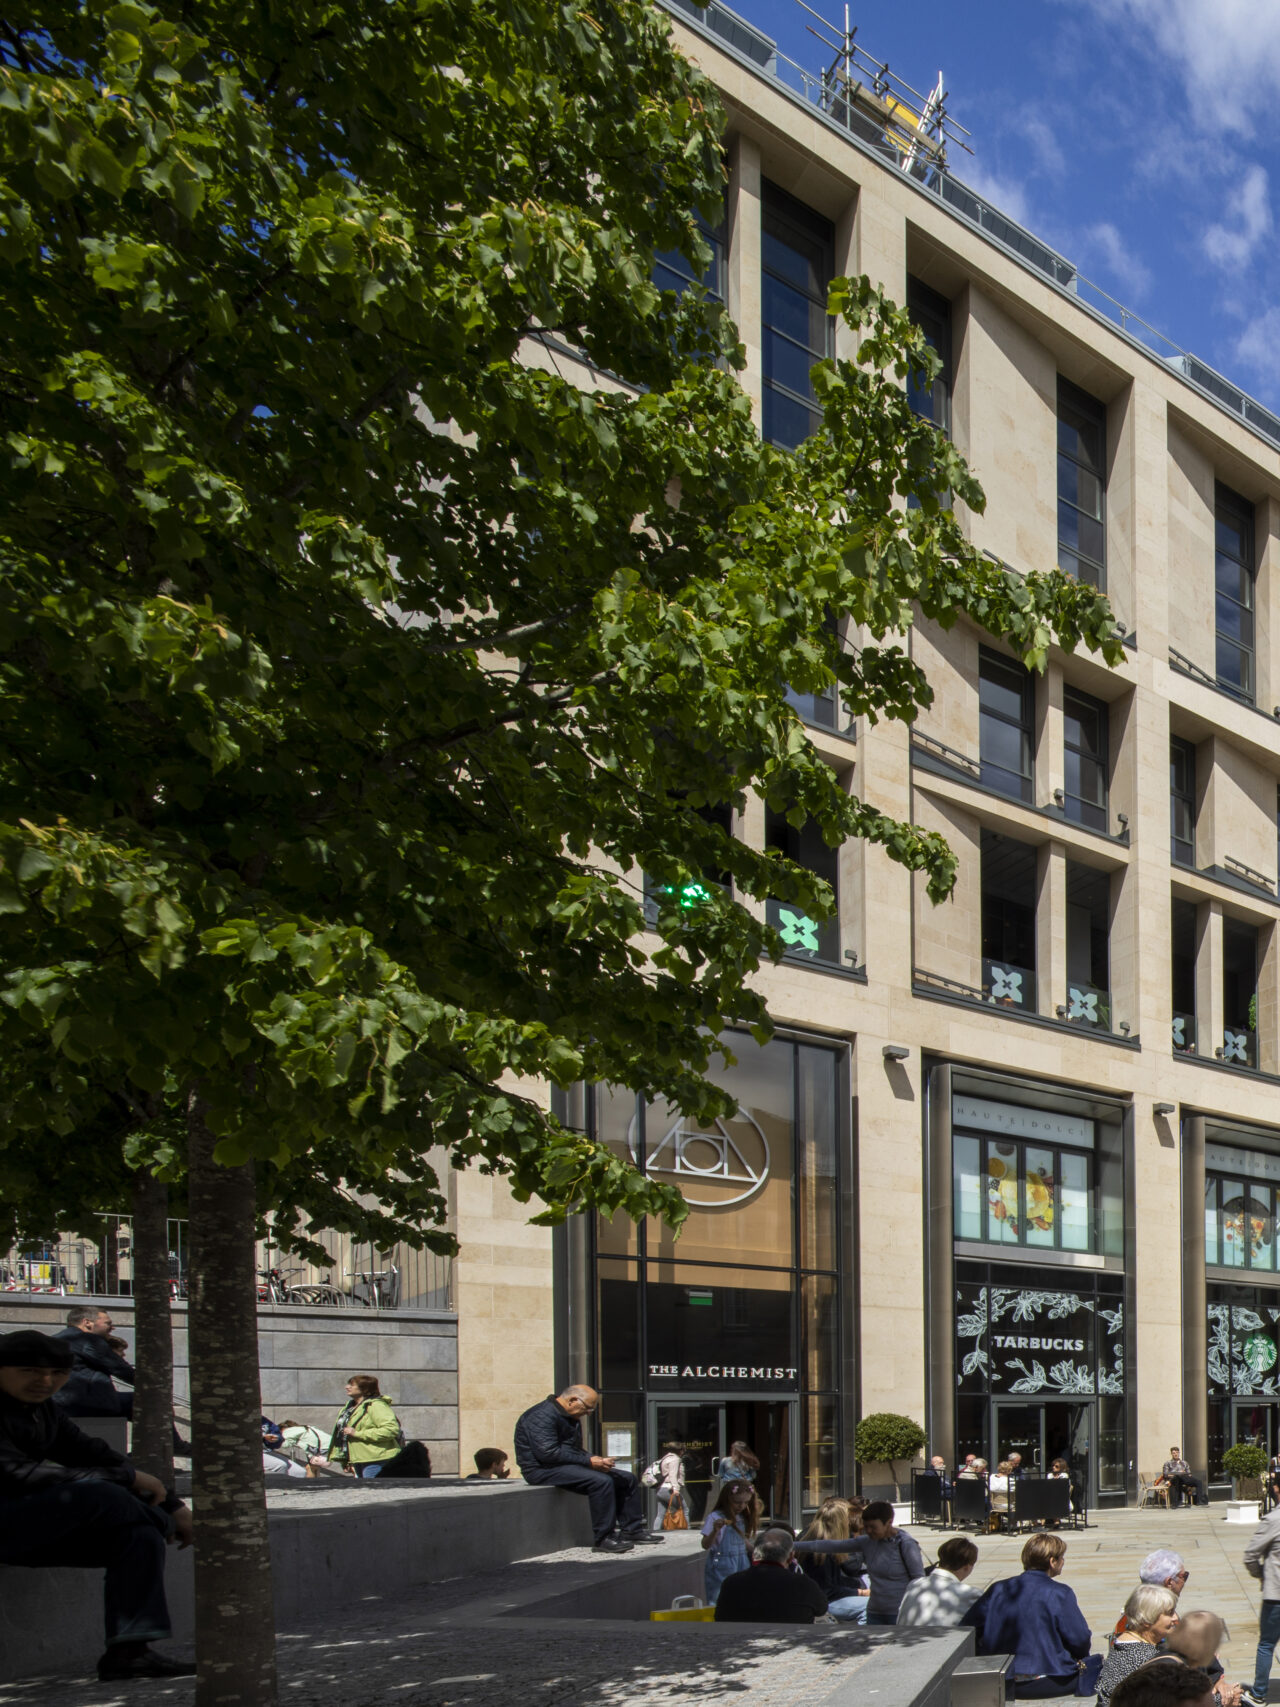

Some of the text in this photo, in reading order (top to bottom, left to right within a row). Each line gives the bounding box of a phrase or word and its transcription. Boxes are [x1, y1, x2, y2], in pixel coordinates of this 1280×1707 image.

[957, 1107, 1084, 1136] HAUTE DOLCI
[1211, 1154, 1243, 1166] AUTE
[649, 1365, 797, 1379] THE ALCHEMIST
